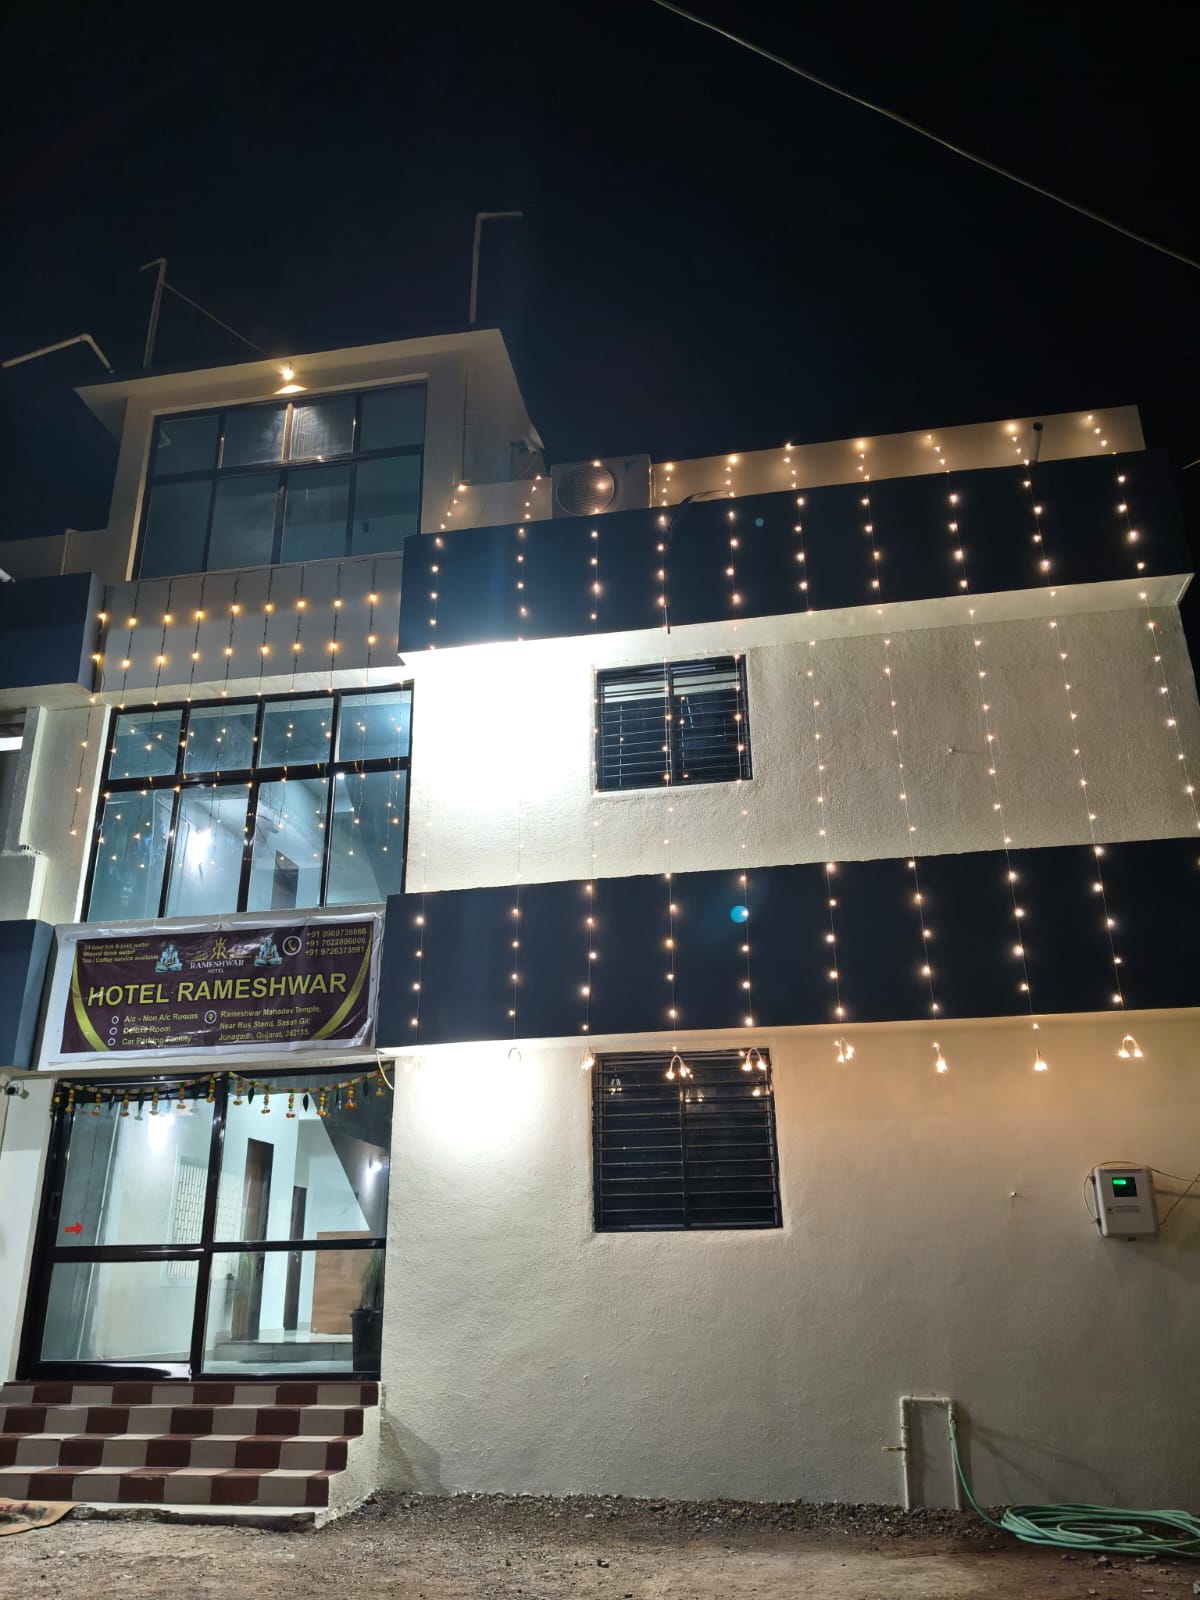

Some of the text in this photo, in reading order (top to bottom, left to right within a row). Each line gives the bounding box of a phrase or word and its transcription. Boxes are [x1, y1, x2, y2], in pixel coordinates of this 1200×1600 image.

[190, 959, 245, 970] RAMESHWAR
[87, 972, 348, 1007] HOTEL RAMESHWAR
[142, 1014, 157, 1022] Non
[172, 1013, 199, 1021] Rooms
[220, 1009, 262, 1018] Rameshwar
[262, 1007, 294, 1016] Mahadev
[149, 1025, 171, 1033] Room
[219, 1022, 236, 1030] Near
[237, 1021, 252, 1029] Bus
[276, 1018, 298, 1027] Sasan
[121, 1038, 135, 1046] Car
[136, 1036, 164, 1046] Parking
